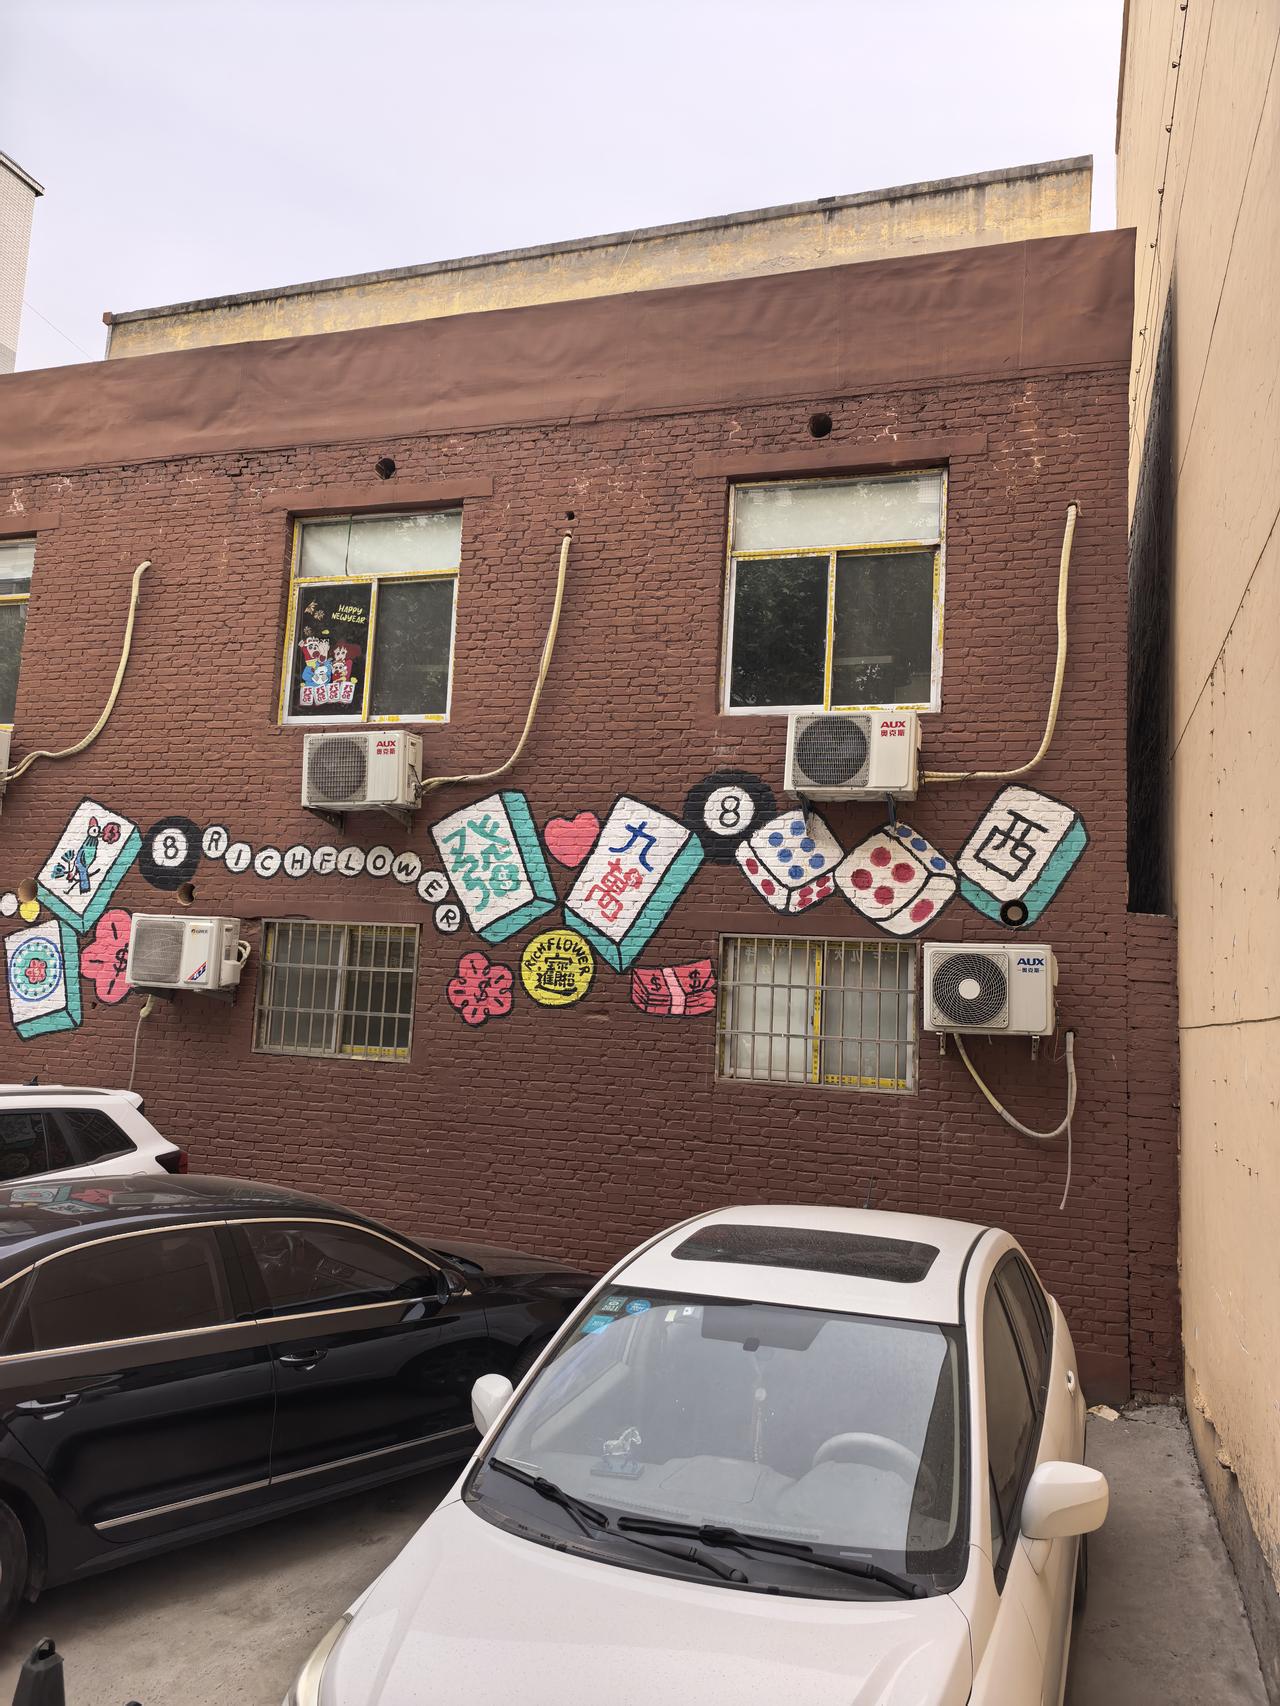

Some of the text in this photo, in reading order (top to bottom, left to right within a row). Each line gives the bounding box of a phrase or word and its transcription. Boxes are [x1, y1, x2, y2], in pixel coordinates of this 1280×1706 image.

[338, 604, 363, 615] HAPPY
[719, 795, 741, 828] 8
[162, 835, 179, 860] 8
[972, 809, 1049, 882] 西
[207, 830, 458, 927] RICHFLOWER
[524, 937, 590, 976] RICHFLOWER
[1016, 957, 1044, 966] AUX
